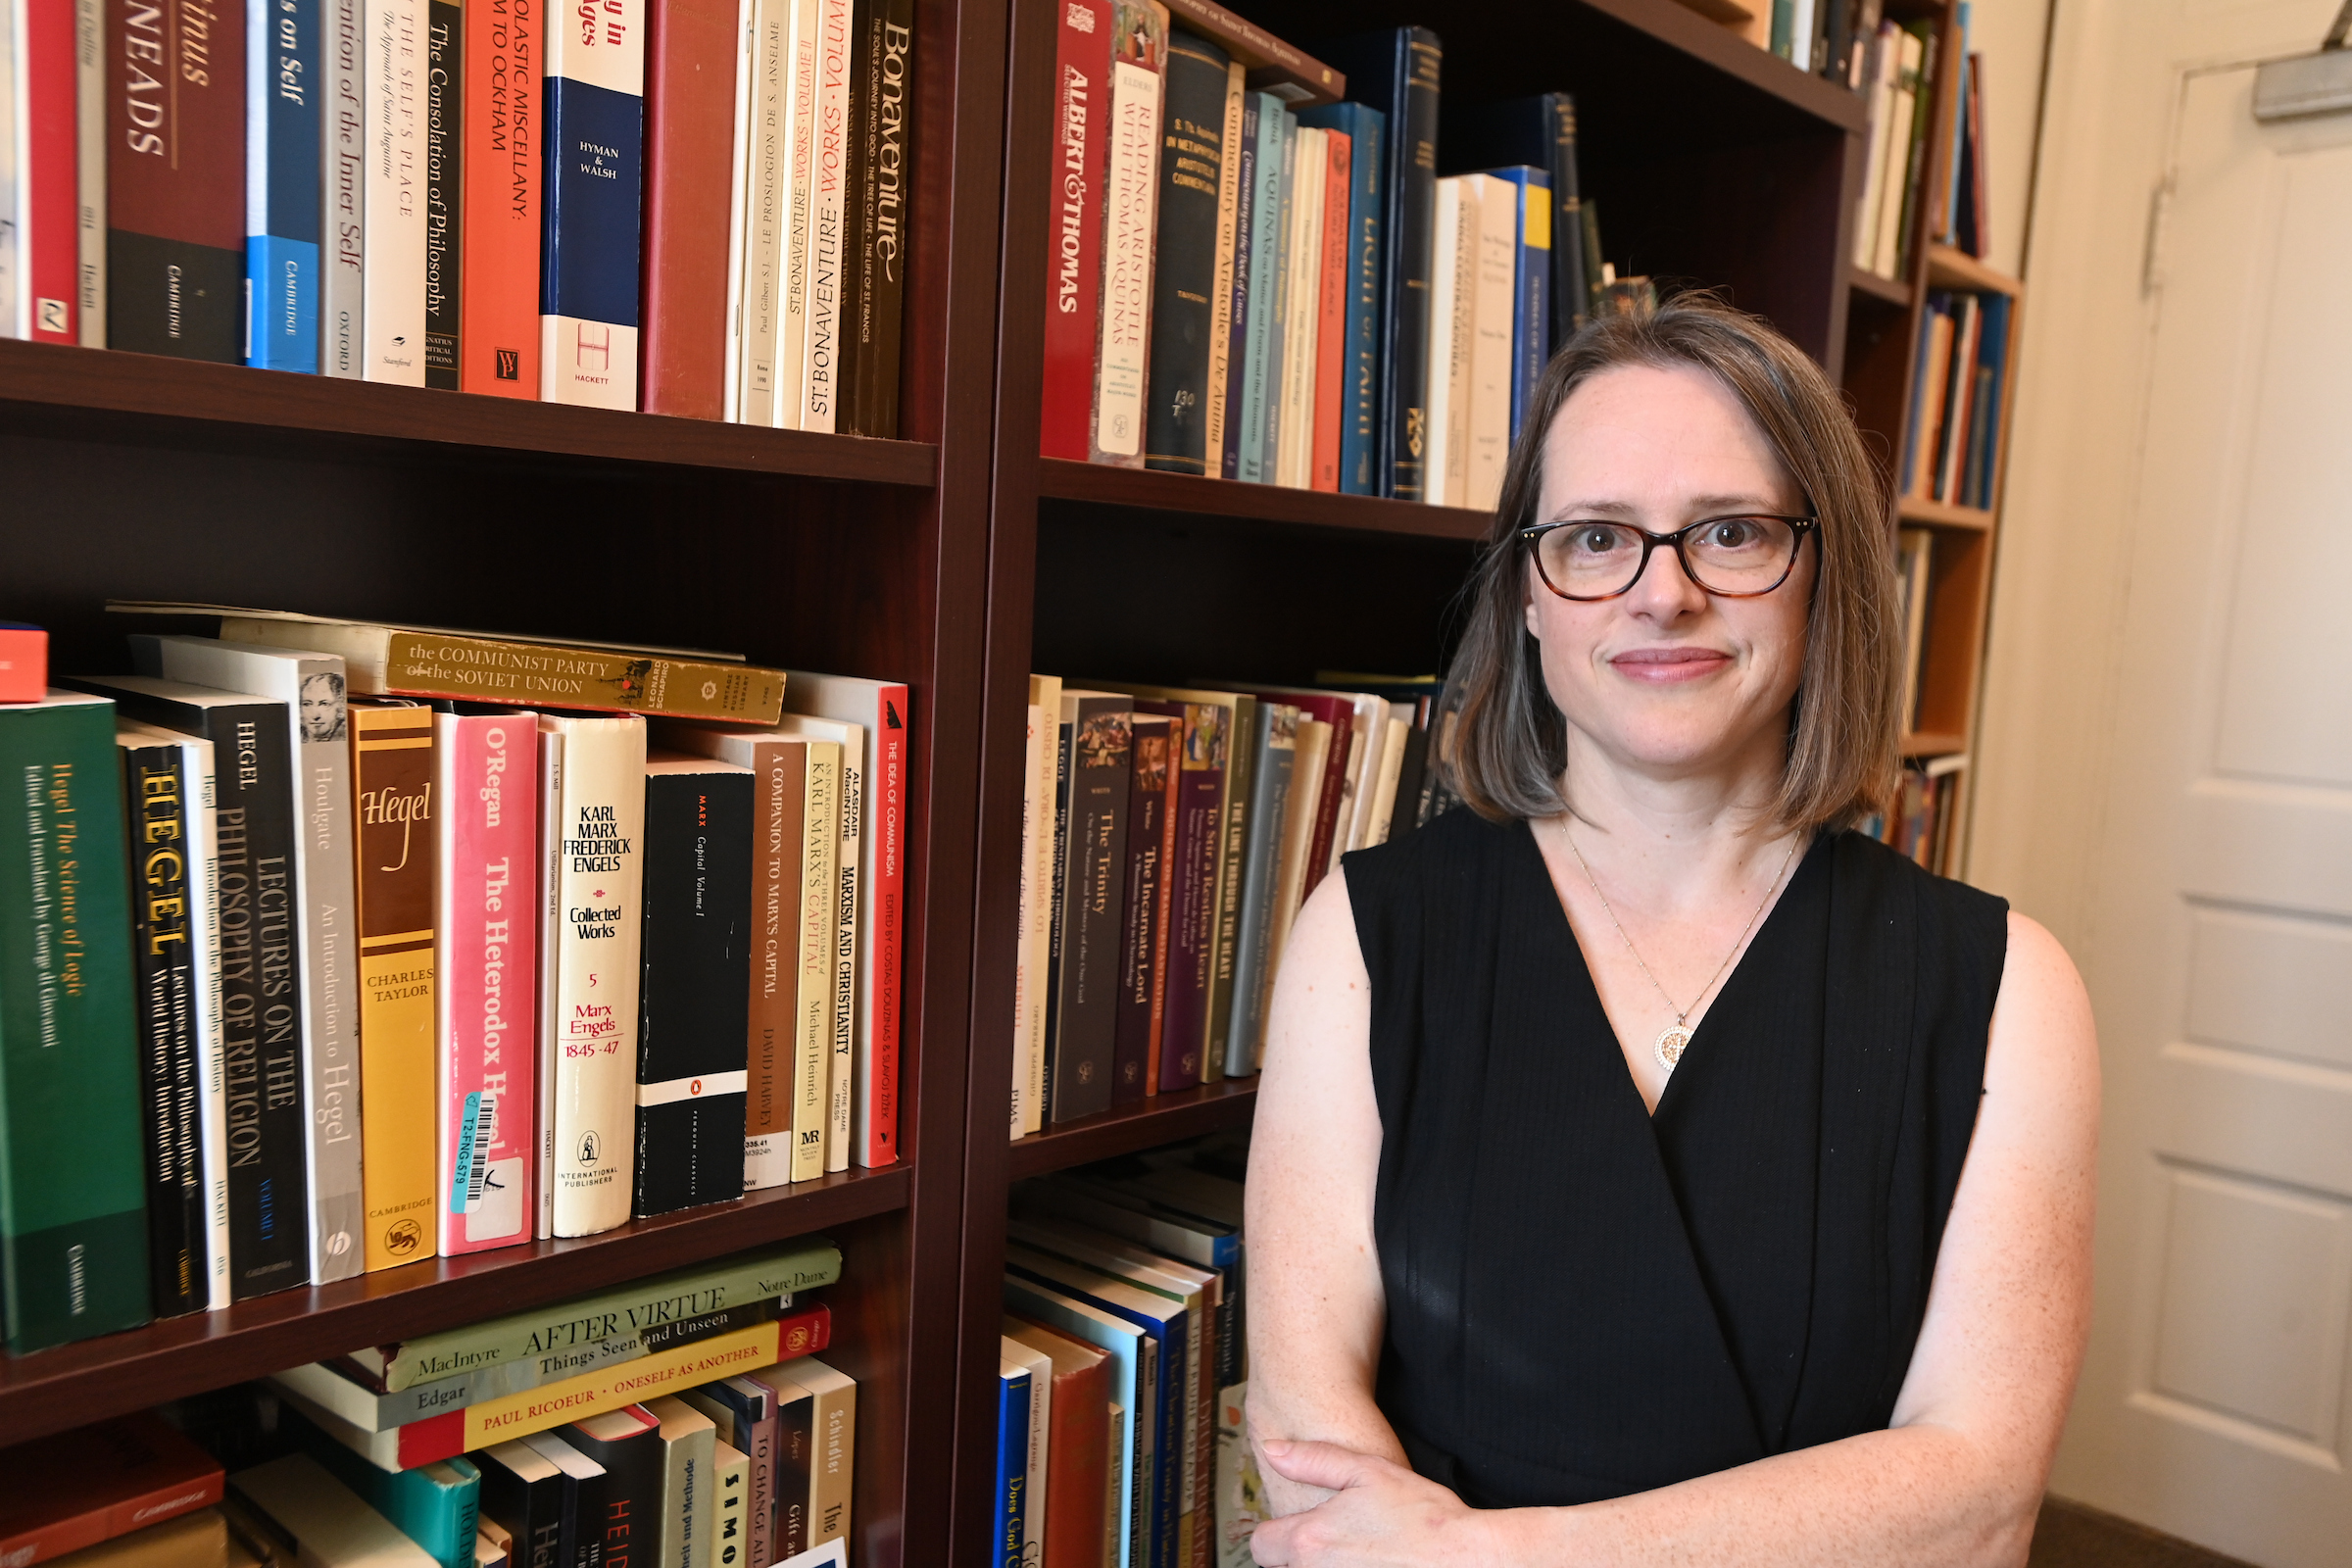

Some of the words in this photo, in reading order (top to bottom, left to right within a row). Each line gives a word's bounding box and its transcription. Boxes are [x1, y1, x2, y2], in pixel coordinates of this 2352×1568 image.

[279, 18, 298, 50] on
[400, 13, 414, 58] THE
[429, 23, 450, 62] The
[493, 22, 508, 49] TO
[606, 23, 626, 46] in
[873, 18, 882, 33] THE
[769, 21, 780, 86] ANSELME
[279, 56, 306, 107] Self
[339, 78, 361, 108] of
[400, 67, 414, 139] SELF'S
[491, 56, 508, 151] OCKHAM
[798, 53, 813, 117] VOLUME
[871, 66, 880, 110] JOURNEY
[1122, 75, 1153, 94] ELDERS
[339, 110, 362, 144] the
[428, 67, 450, 180] Consolation
[767, 109, 776, 127] DE
[869, 111, 879, 133] INTO
[1066, 67, 1088, 175] ALBERT
[1121, 102, 1135, 156] WITH
[511, 88, 529, 220] MISCELLANY:
[579, 141, 619, 160] HYMAN
[594, 156, 605, 167] &
[796, 125, 810, 180] WORKS
[821, 105, 842, 194] WORKS
[868, 134, 877, 157] GOD
[874, 21, 911, 283] Bonaventure
[1134, 105, 1151, 214] READING
[1220, 91, 1242, 220] Commentary
[339, 148, 362, 216] Inner
[399, 148, 414, 218] PLACE
[579, 164, 617, 180] WALSH
[763, 134, 776, 224] PROSLOGION
[866, 182, 875, 202] TREE
[428, 187, 448, 212] of
[1116, 166, 1133, 249] THOMAS
[338, 220, 363, 273] Self
[791, 187, 808, 293] BONAVENTURE
[1058, 203, 1082, 314] THOMAS
[1222, 223, 1234, 248] on
[425, 212, 448, 318] Philosophy
[1127, 224, 1146, 349] ARISTOTLE
[814, 208, 838, 383] BONAVENTURE
[1109, 258, 1127, 346] AQUINAS
[1216, 258, 1233, 350] Aristotle's
[338, 311, 350, 371] OXFORD
[760, 316, 769, 334] Paul
[861, 304, 871, 343] FRANCIS
[382, 356, 413, 368] Stanford
[574, 372, 611, 385] HACKETT
[757, 375, 767, 384] 1990
[1214, 354, 1227, 381] De
[1210, 385, 1224, 444] Anima
[410, 643, 436, 664] the
[439, 646, 554, 674] COMMUNIST
[557, 658, 610, 682] PARTY
[454, 668, 522, 690] SOVIET
[525, 673, 585, 695] UNION
[648, 660, 662, 709] LEONARD
[656, 662, 669, 710] SCHAPIRO
[722, 673, 734, 710] VINTAGE
[730, 675, 742, 711] RUSSIAN
[739, 675, 750, 710] LIBRARY
[237, 720, 258, 791] HEGEL
[886, 741, 898, 760] THE
[886, 761, 898, 786] IDEA
[47, 762, 77, 814] Hegel
[479, 726, 508, 828] O'Regan
[811, 761, 825, 813] KARL
[887, 788, 898, 805] OF
[311, 765, 334, 852] Houlgate
[361, 781, 432, 873] Hegel
[580, 806, 616, 822] KARL
[698, 795, 707, 827] MARX
[769, 766, 784, 855] COMPANION
[821, 778, 833, 858] INTRODUCTION
[843, 766, 854, 843] MacINTYRE
[851, 771, 860, 838] ALASDAIR
[1098, 808, 1114, 848] The
[564, 838, 631, 856] FREDERICK
[577, 822, 617, 839] MARX
[694, 836, 707, 871] Capital
[808, 818, 822, 889] MARX'S
[884, 807, 897, 877] COMMUNISM
[140, 763, 187, 956] HEGEL
[485, 856, 511, 912] The
[573, 856, 620, 873] ENGELS
[768, 857, 782, 880] TO
[1092, 851, 1112, 915] Trinity
[1142, 845, 1157, 879] The
[216, 806, 255, 984] PHILOSOPHY
[570, 906, 621, 923] Collected
[695, 877, 706, 910] Volume
[766, 883, 781, 937] MARX'S
[841, 866, 856, 926] MARXISM
[884, 893, 895, 928] EDITED
[257, 854, 292, 998] LECTURES
[577, 924, 615, 940] Works
[805, 894, 821, 976] CAPITAL
[819, 916, 828, 963] VOLUMES
[839, 929, 854, 958] AND
[1137, 882, 1154, 960] Incarnate
[322, 931, 342, 1038] Introduction
[367, 967, 435, 989] CHARLES
[589, 973, 598, 988] 5
[764, 940, 779, 1000] CAPITAL
[883, 944, 894, 986] COSTAS
[1134, 962, 1150, 1004] Lord
[374, 984, 429, 1004] TAYLOR
[484, 917, 511, 1067] Heterodox
[575, 1004, 612, 1019] Marx
[836, 961, 853, 1055] CHRISTIANITY
[263, 1003, 293, 1046] ON
[570, 1017, 615, 1038] Engels
[761, 1027, 775, 1070] DAVID
[808, 1000, 821, 1053] Michael
[225, 1035, 263, 1169] RELIGION
[267, 1049, 297, 1111] THE
[316, 1063, 353, 1147] Hegel
[760, 1074, 773, 1128] HARVEY
[806, 1054, 820, 1107] Heinrich
[1008, 1088, 1020, 1125] PIMS
[155, 1085, 178, 1184] Introduction
[456, 1117, 475, 1184] T2-FNG-579
[558, 1166, 618, 1180] INTERNATIONAL
[564, 1176, 612, 1189] PUBLISHERS
[368, 1196, 434, 1219] CAMBRIDGE
[417, 1347, 501, 1377] MacIntyre
[522, 1311, 618, 1357] AFTER
[626, 1286, 726, 1331] VIRTUE
[757, 1277, 792, 1296] Notre
[793, 1268, 829, 1288] Dame
[416, 1386, 466, 1411] Edgar
[539, 1350, 596, 1375] Things
[602, 1337, 638, 1357] Seen
[642, 1325, 670, 1348] and
[675, 1312, 729, 1338] Unseen
[483, 1411, 523, 1432] PAUL
[527, 1390, 597, 1419] RICOEUR
[613, 1368, 676, 1395] ONESELF
[677, 1363, 695, 1379] AS
[697, 1345, 760, 1374] ANOTHER
[757, 1434, 769, 1458] TO
[828, 1408, 844, 1475] Schindler
[682, 1457, 696, 1515] Methode
[754, 1464, 768, 1536] CHANGE
[681, 1515, 694, 1541] und
[823, 1501, 843, 1534] The
